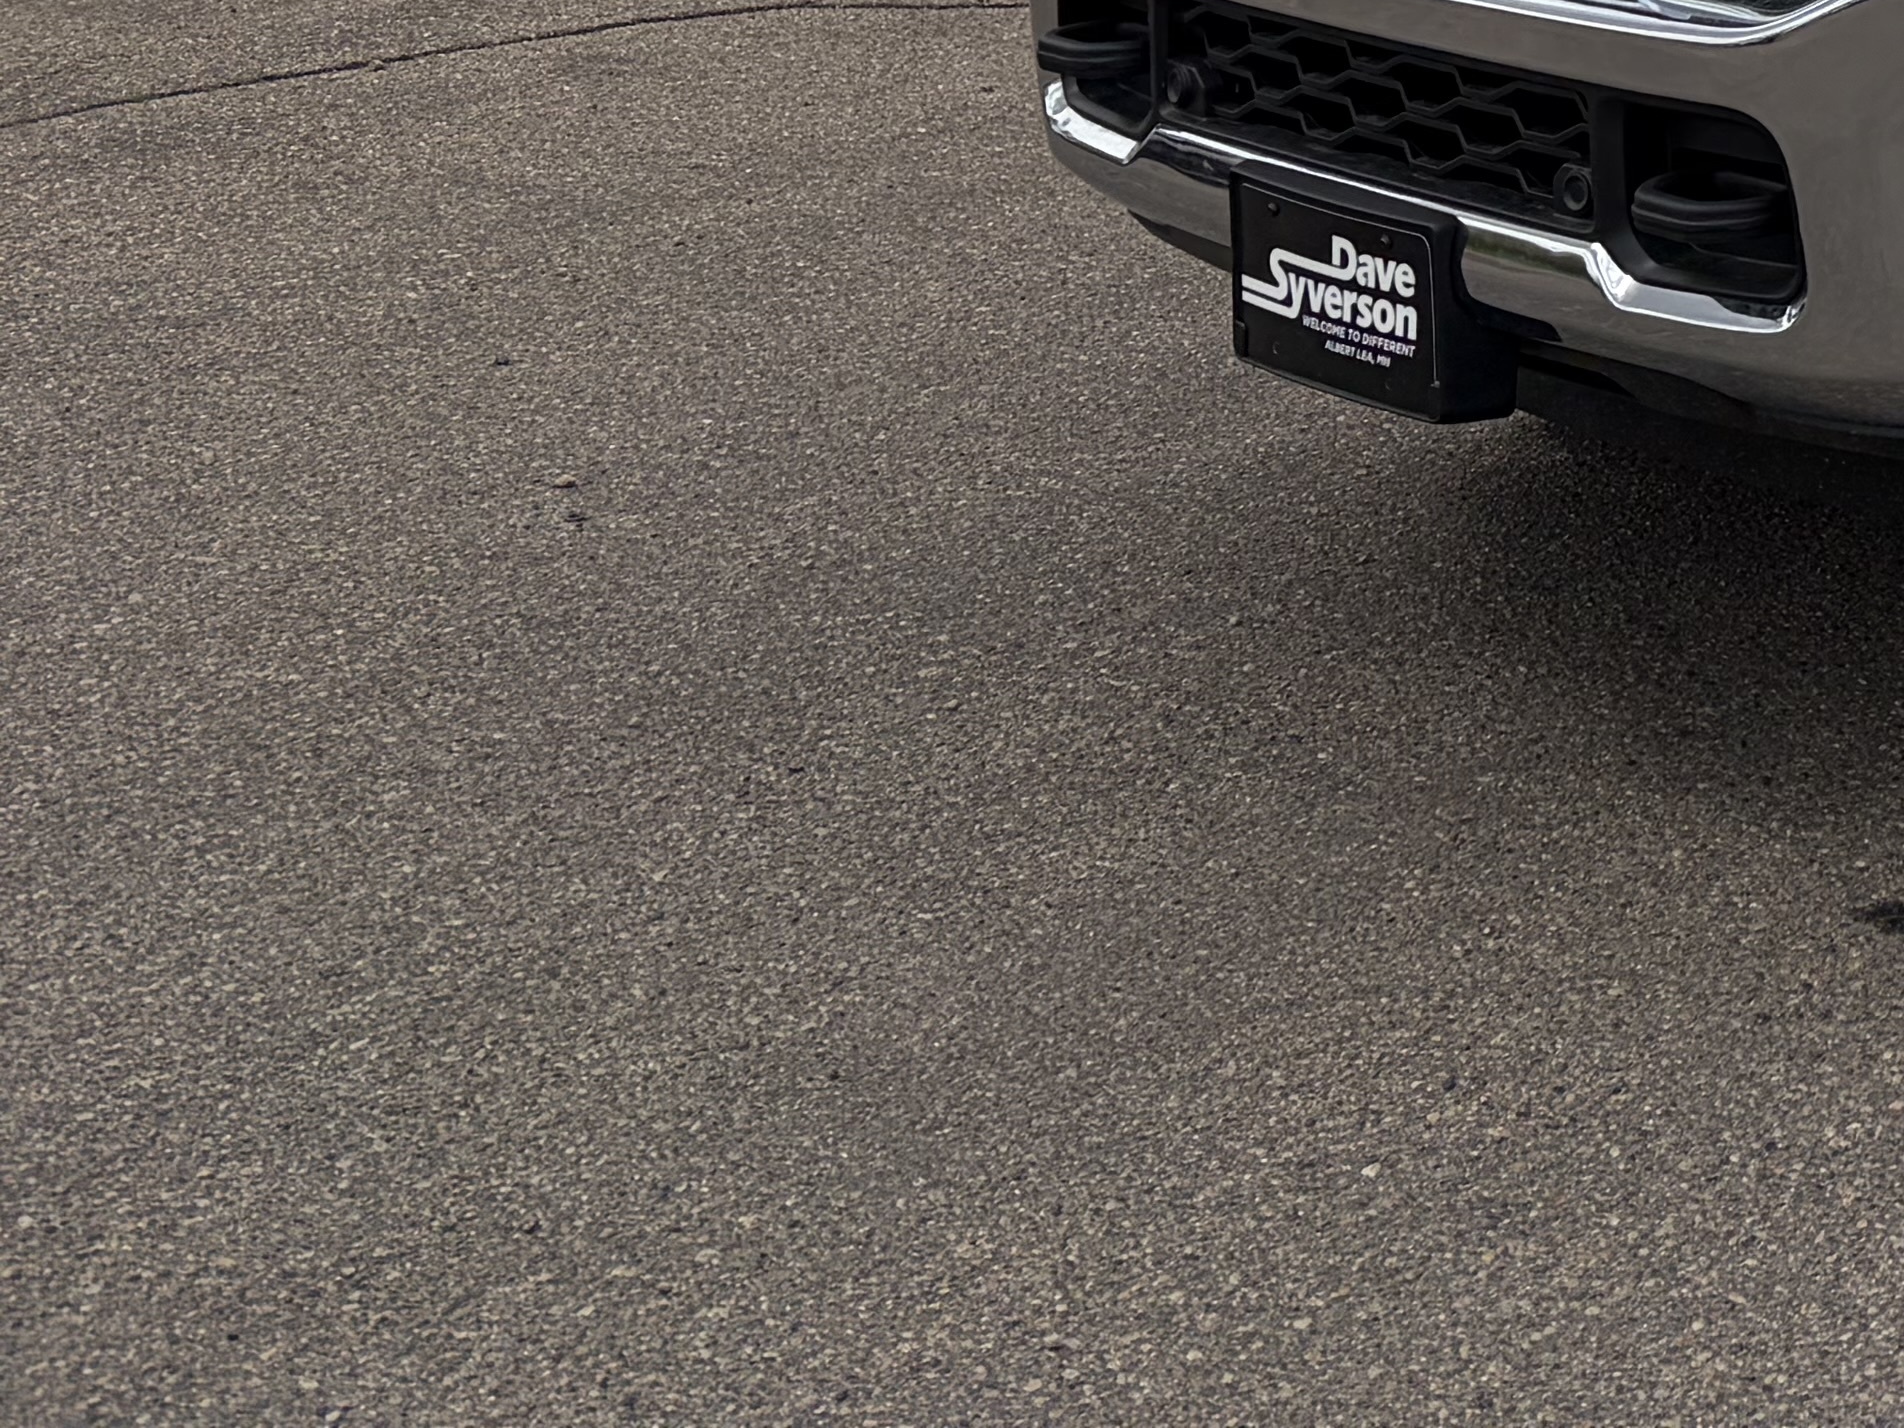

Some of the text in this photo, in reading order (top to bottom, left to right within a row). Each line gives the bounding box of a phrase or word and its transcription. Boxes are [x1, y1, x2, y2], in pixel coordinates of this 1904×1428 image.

[1332, 234, 1416, 298] Dave
[1242, 247, 1417, 341] Syverson
[1302, 314, 1416, 358] WELCOME TO DIFFERENT
[1325, 340, 1356, 358] ALBERT
